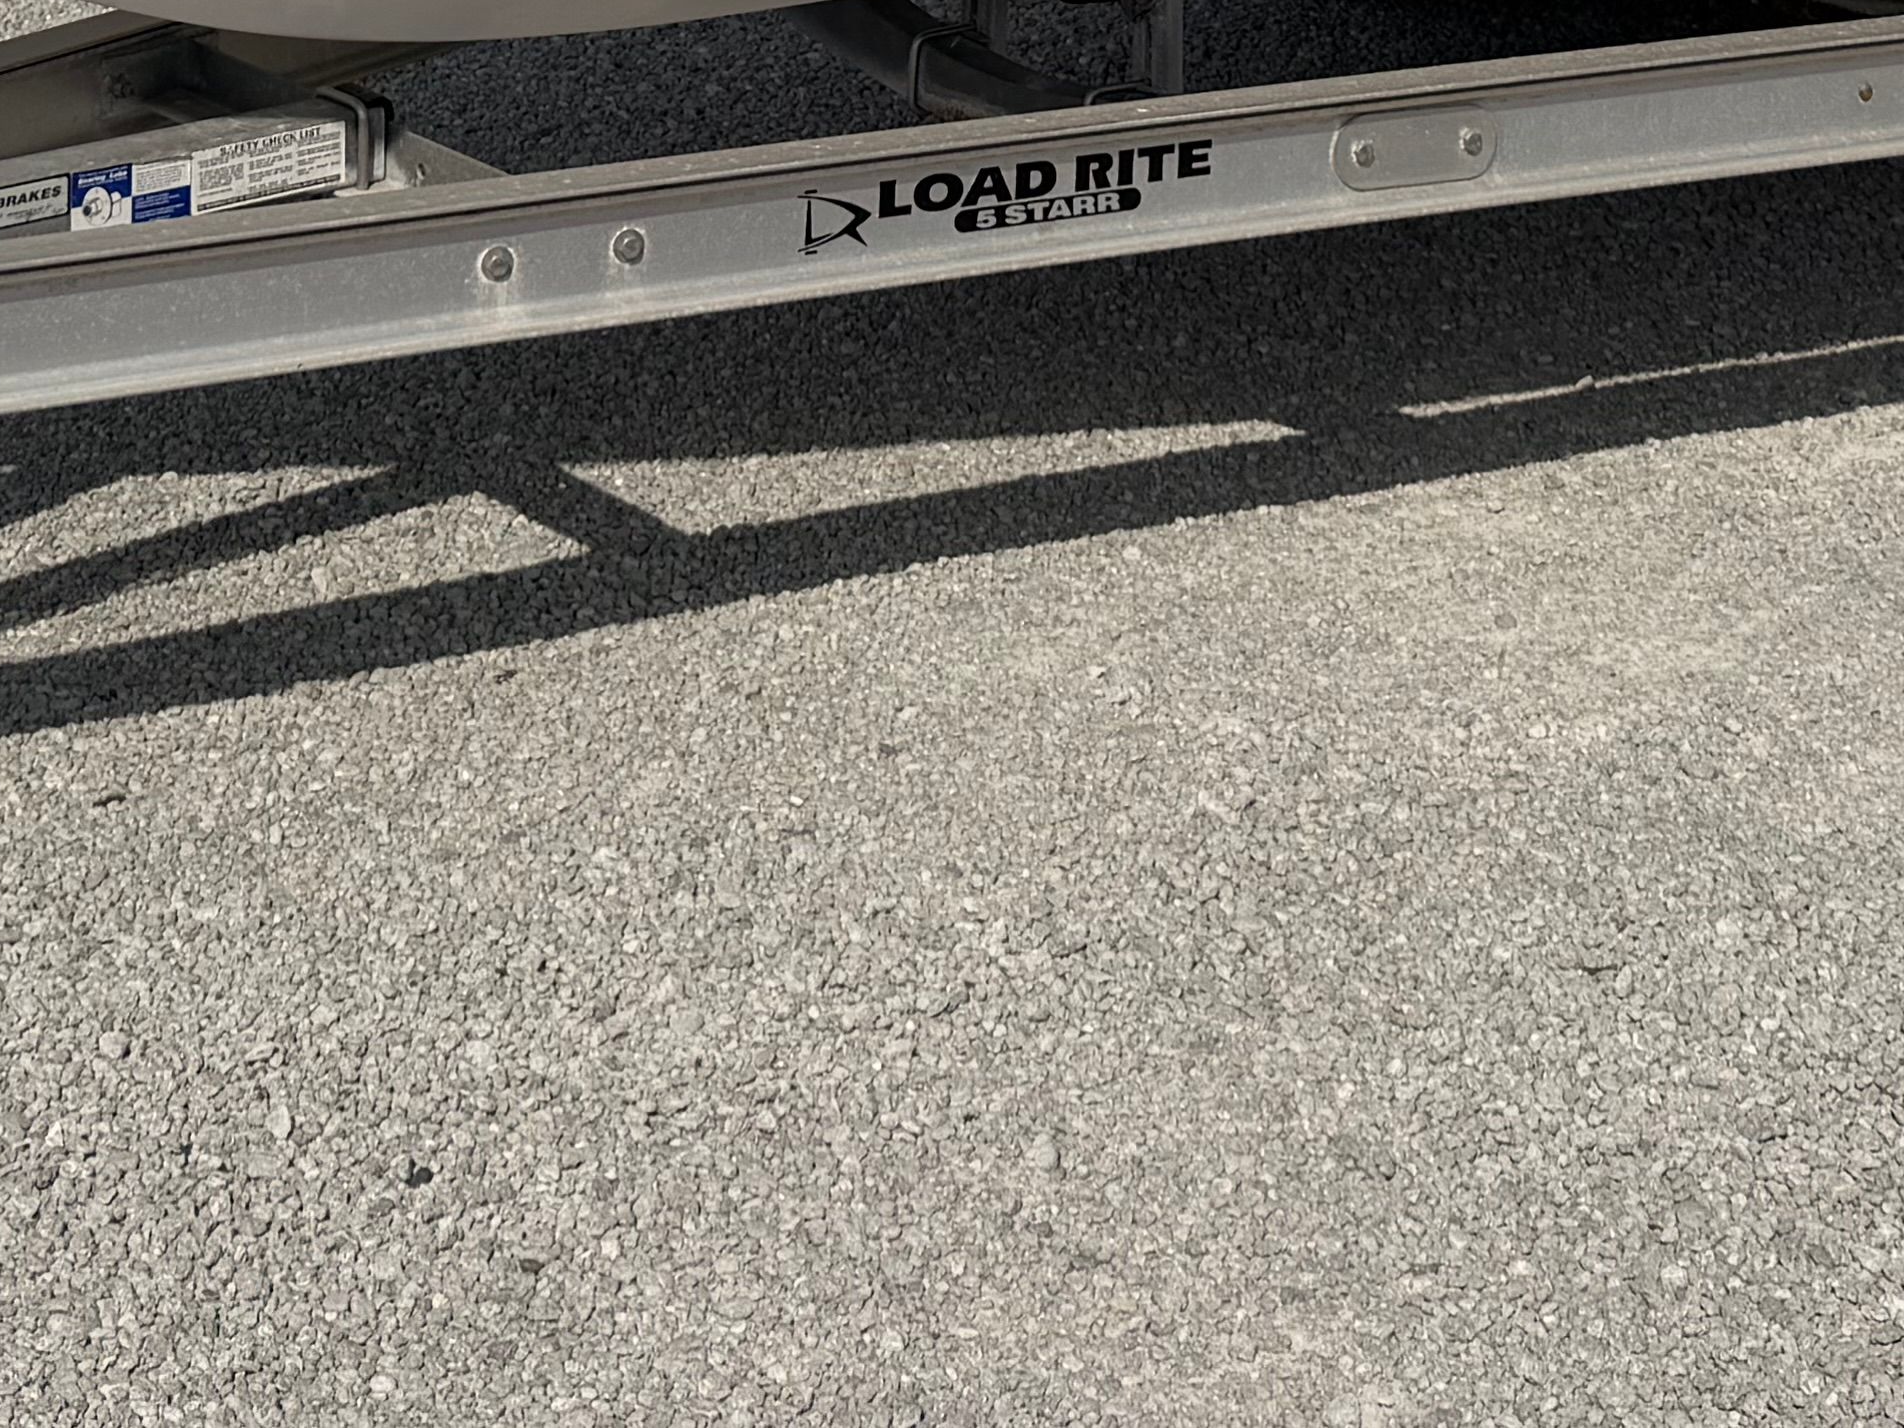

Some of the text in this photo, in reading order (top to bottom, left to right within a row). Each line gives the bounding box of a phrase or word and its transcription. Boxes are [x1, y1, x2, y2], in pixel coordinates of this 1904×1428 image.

[877, 139, 1213, 218] LOAD RITE
[975, 191, 1120, 229] 5 STARR
